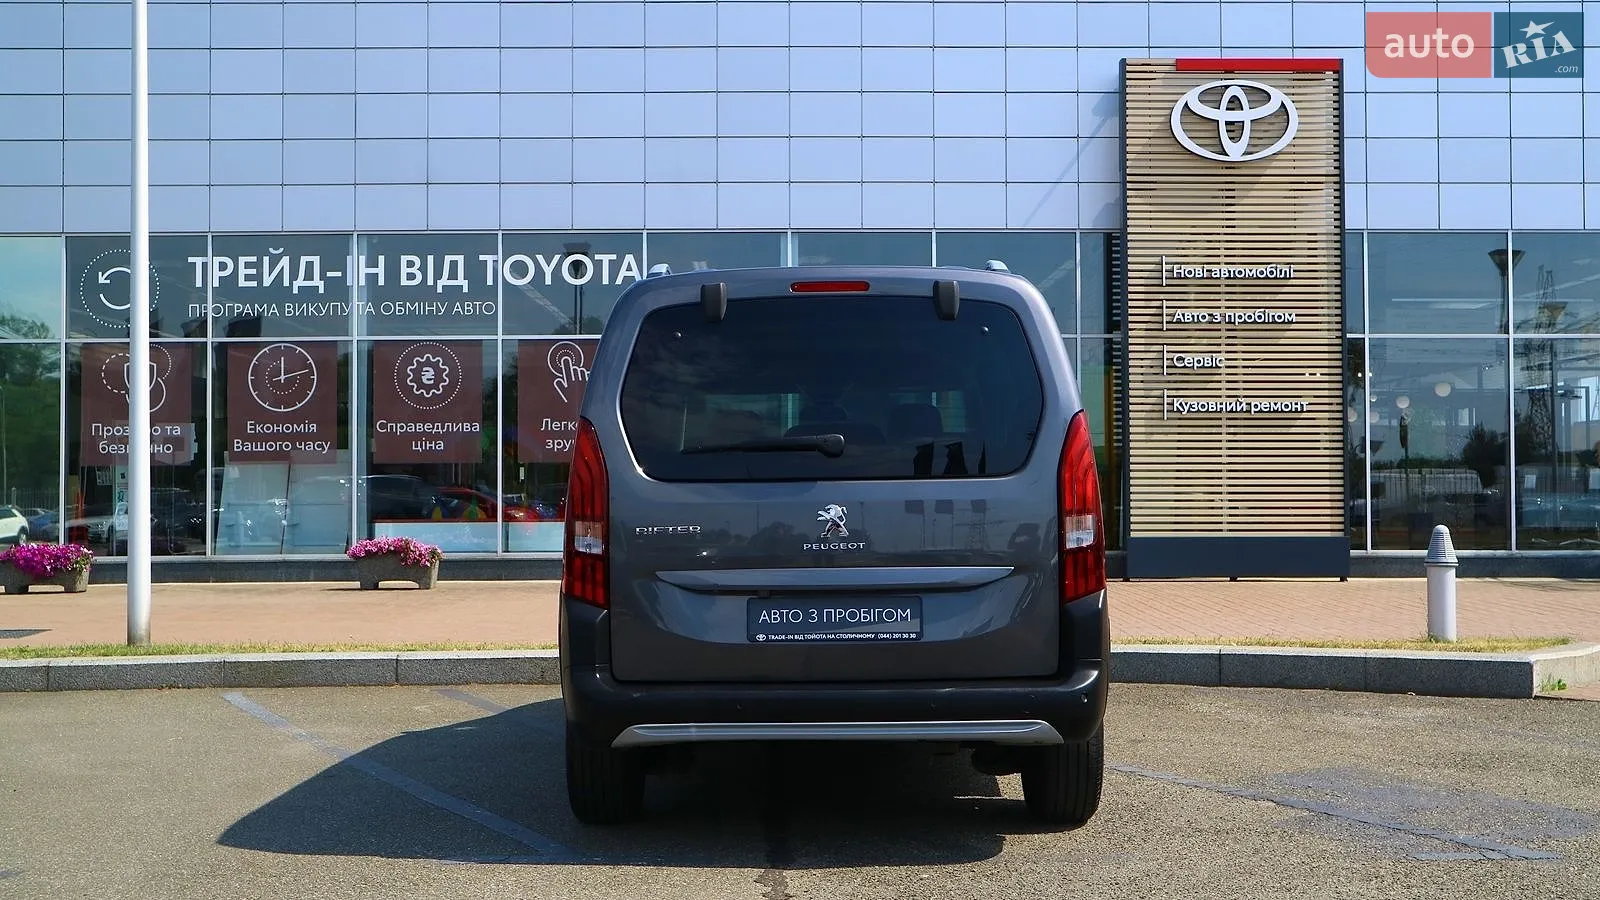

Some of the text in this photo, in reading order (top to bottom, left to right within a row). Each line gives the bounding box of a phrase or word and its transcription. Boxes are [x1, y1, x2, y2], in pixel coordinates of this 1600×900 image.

[187, 247, 642, 294] ТРЕЙД-ІН ВІД TOYOTA
[1173, 265, 1294, 279] Нові автомобілі
[188, 302, 496, 318] ПРОГРАМА ВИКУПУ ТА ОБМІНУ АВТО
[1173, 309, 1296, 325] Авто з пробігом
[1173, 354, 1225, 370] Сервіс
[1173, 398, 1309, 414] Кузовний ремонт
[91, 423, 181, 438] Прозо та
[246, 420, 317, 433] Економія
[376, 420, 480, 433] Справедлива
[99, 440, 173, 454] безно
[233, 440, 331, 454] Вашого часу
[412, 438, 444, 451] ціна
[635, 525, 701, 535] RIFTER
[803, 542, 866, 551] PEUGEOT
[758, 608, 912, 624] АВТО З ПРОБІГОМ
[794, 633, 804, 641] ВІД
